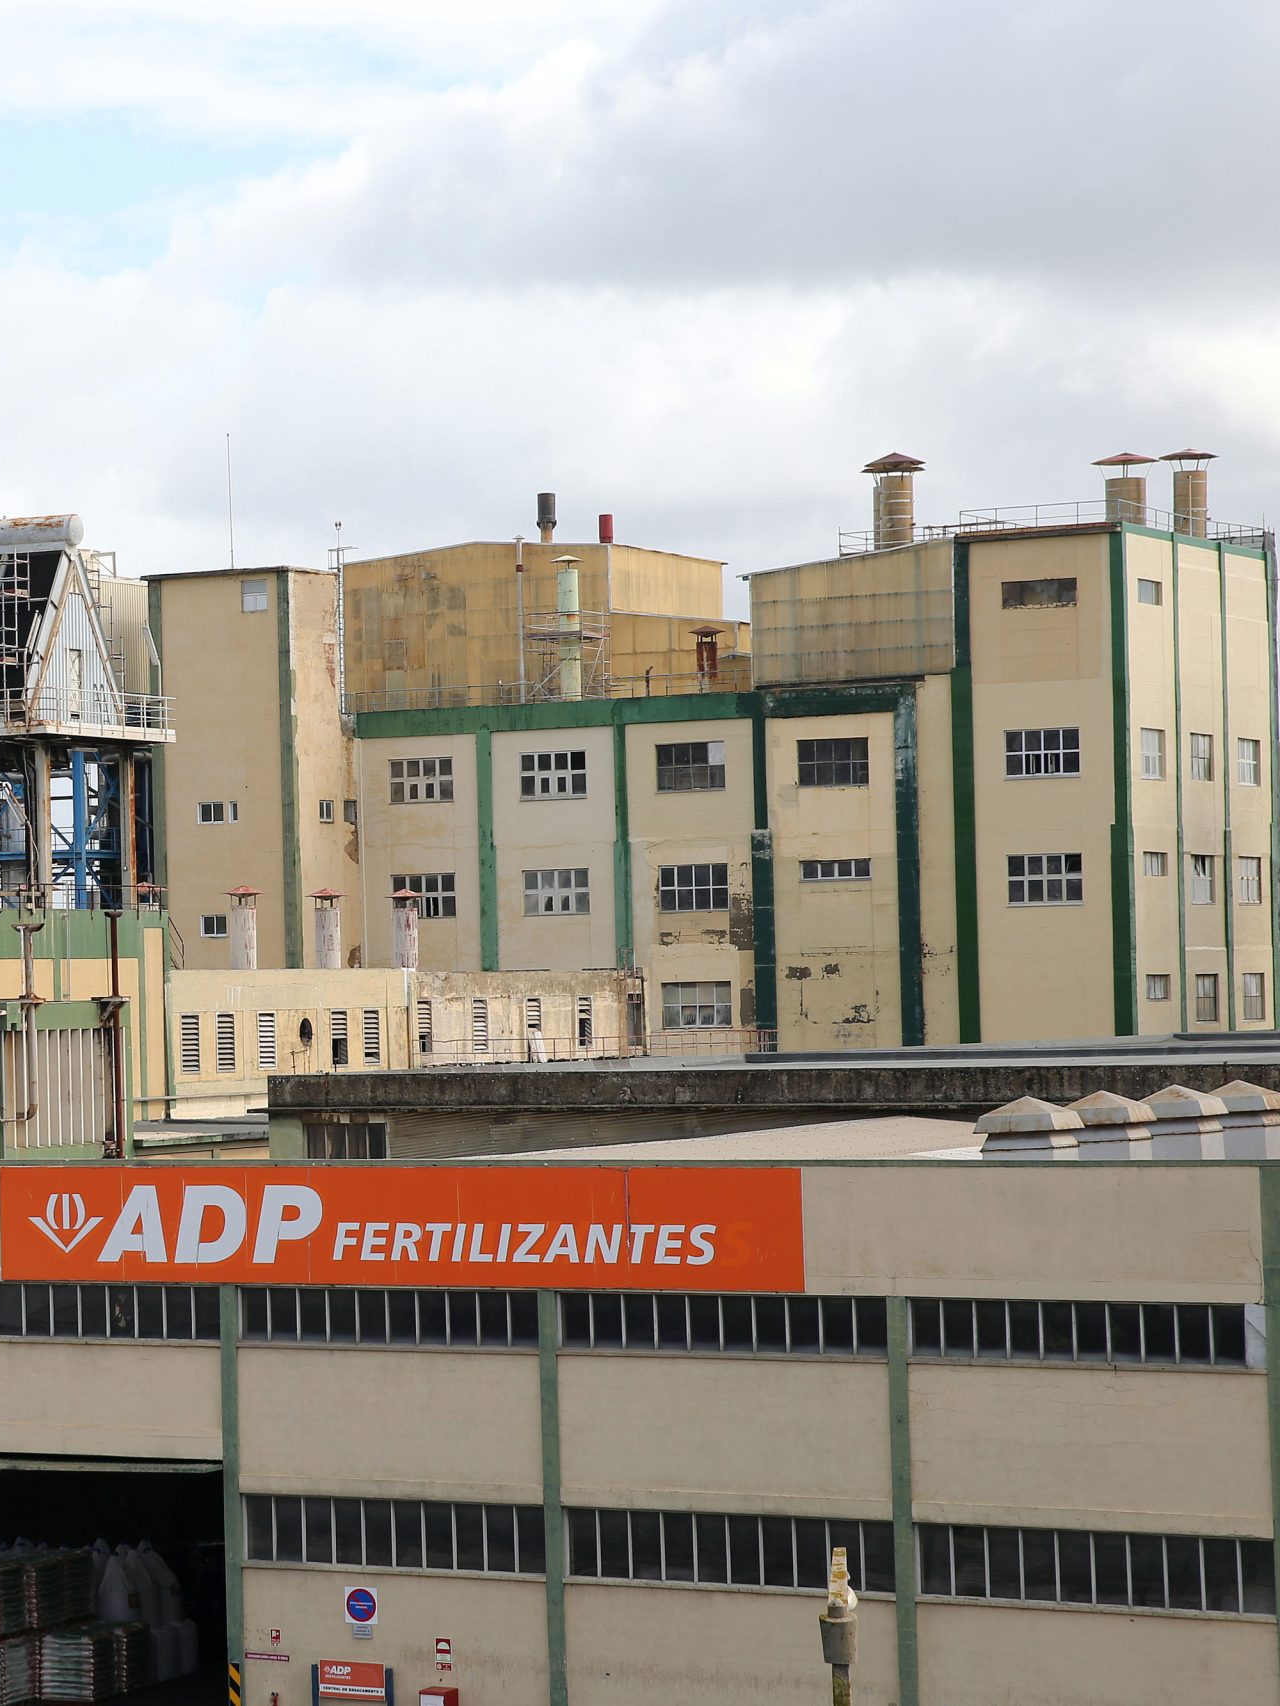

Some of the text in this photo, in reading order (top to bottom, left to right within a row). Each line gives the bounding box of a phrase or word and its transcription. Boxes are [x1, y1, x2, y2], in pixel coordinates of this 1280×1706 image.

[97, 1185, 717, 1266] ADP FERTILIZANTES
[330, 1665, 351, 1674] ADP
